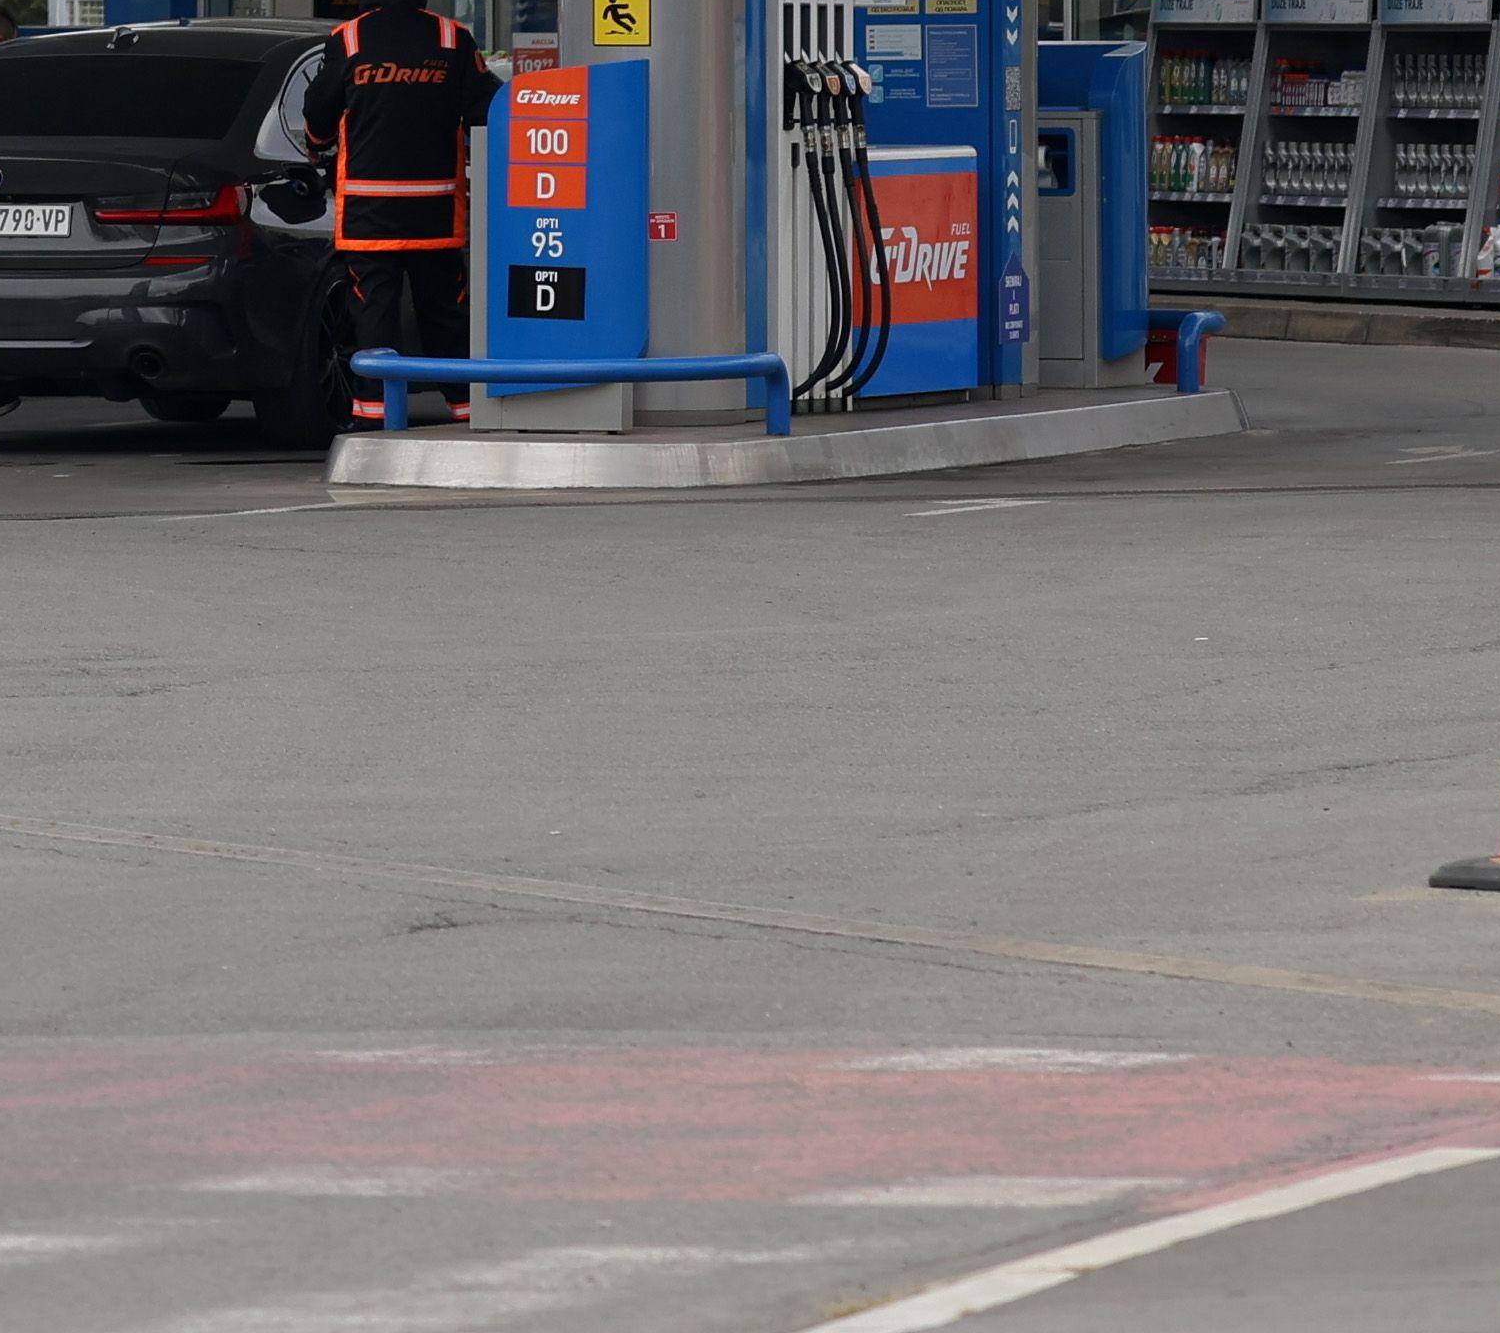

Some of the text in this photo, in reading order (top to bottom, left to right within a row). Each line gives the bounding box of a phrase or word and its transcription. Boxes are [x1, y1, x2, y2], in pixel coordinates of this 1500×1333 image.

[526, 128, 569, 154] 100
[536, 172, 555, 199] D
[536, 218, 559, 229] OPTI
[658, 225, 665, 238] 1
[951, 223, 971, 235] FUEL
[531, 232, 563, 258] 95
[535, 271, 558, 282] OPTI
[536, 285, 555, 311] D
